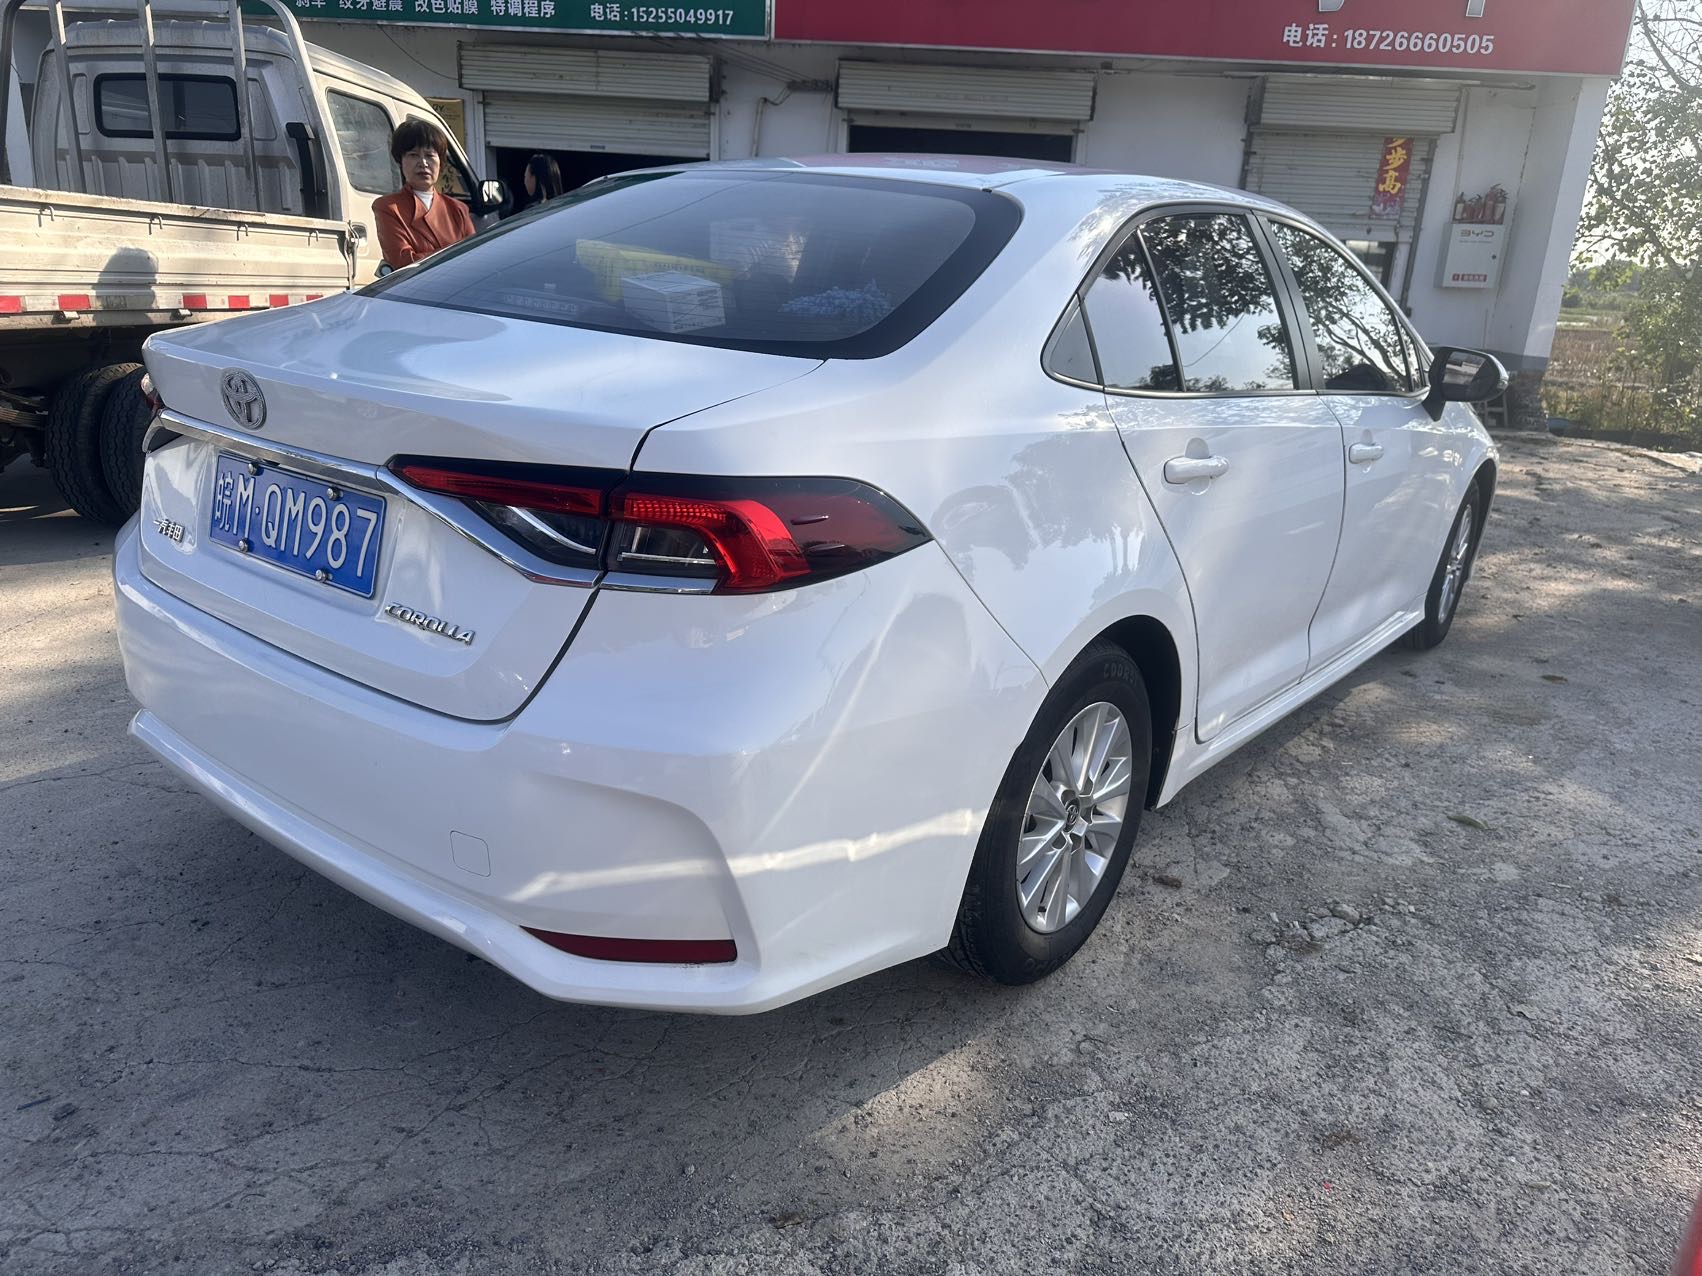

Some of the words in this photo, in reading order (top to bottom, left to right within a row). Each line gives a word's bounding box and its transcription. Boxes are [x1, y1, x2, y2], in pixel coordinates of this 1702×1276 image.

[415, 0, 479, 15] 改色贴膜
[490, 0, 556, 18] 特调程序
[590, 3, 734, 25] 电话:15255049917
[1283, 23, 1495, 54] 电话:18726660505
[215, 472, 378, 577] 皖M·QM987
[384, 602, 476, 646] COROLLA
